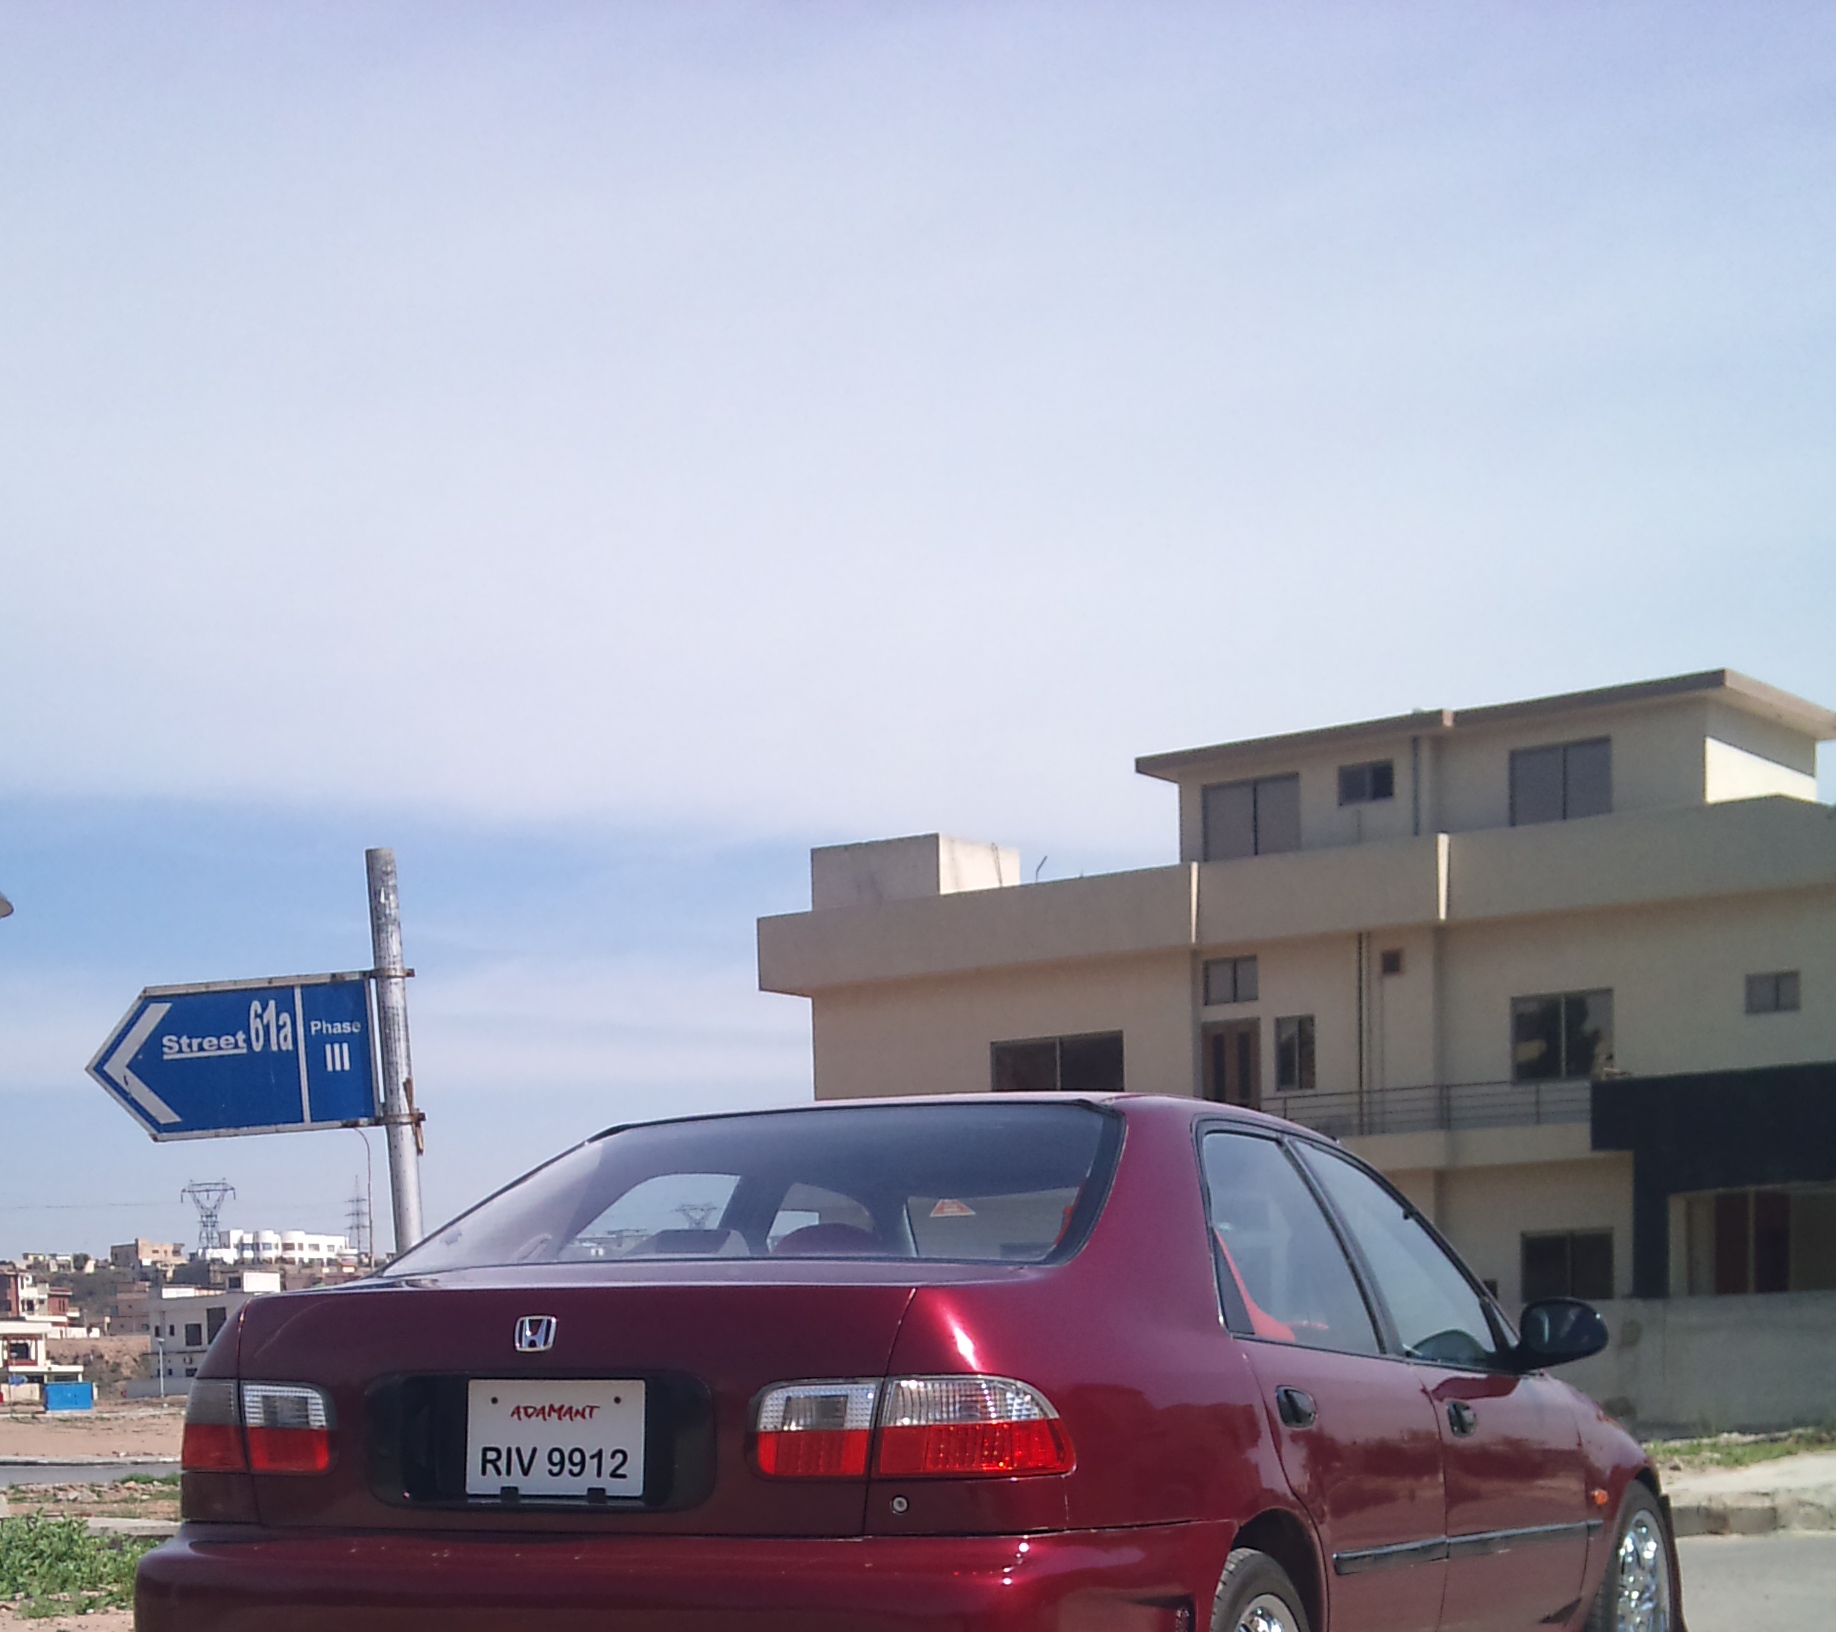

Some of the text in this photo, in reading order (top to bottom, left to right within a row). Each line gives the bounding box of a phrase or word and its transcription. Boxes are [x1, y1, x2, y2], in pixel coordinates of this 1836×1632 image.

[162, 999, 293, 1055] Street 61a
[310, 1019, 361, 1035] Phase
[325, 1043, 350, 1072] III
[510, 1404, 600, 1421] ADAMANT
[480, 1446, 628, 1479] RIV 9912
